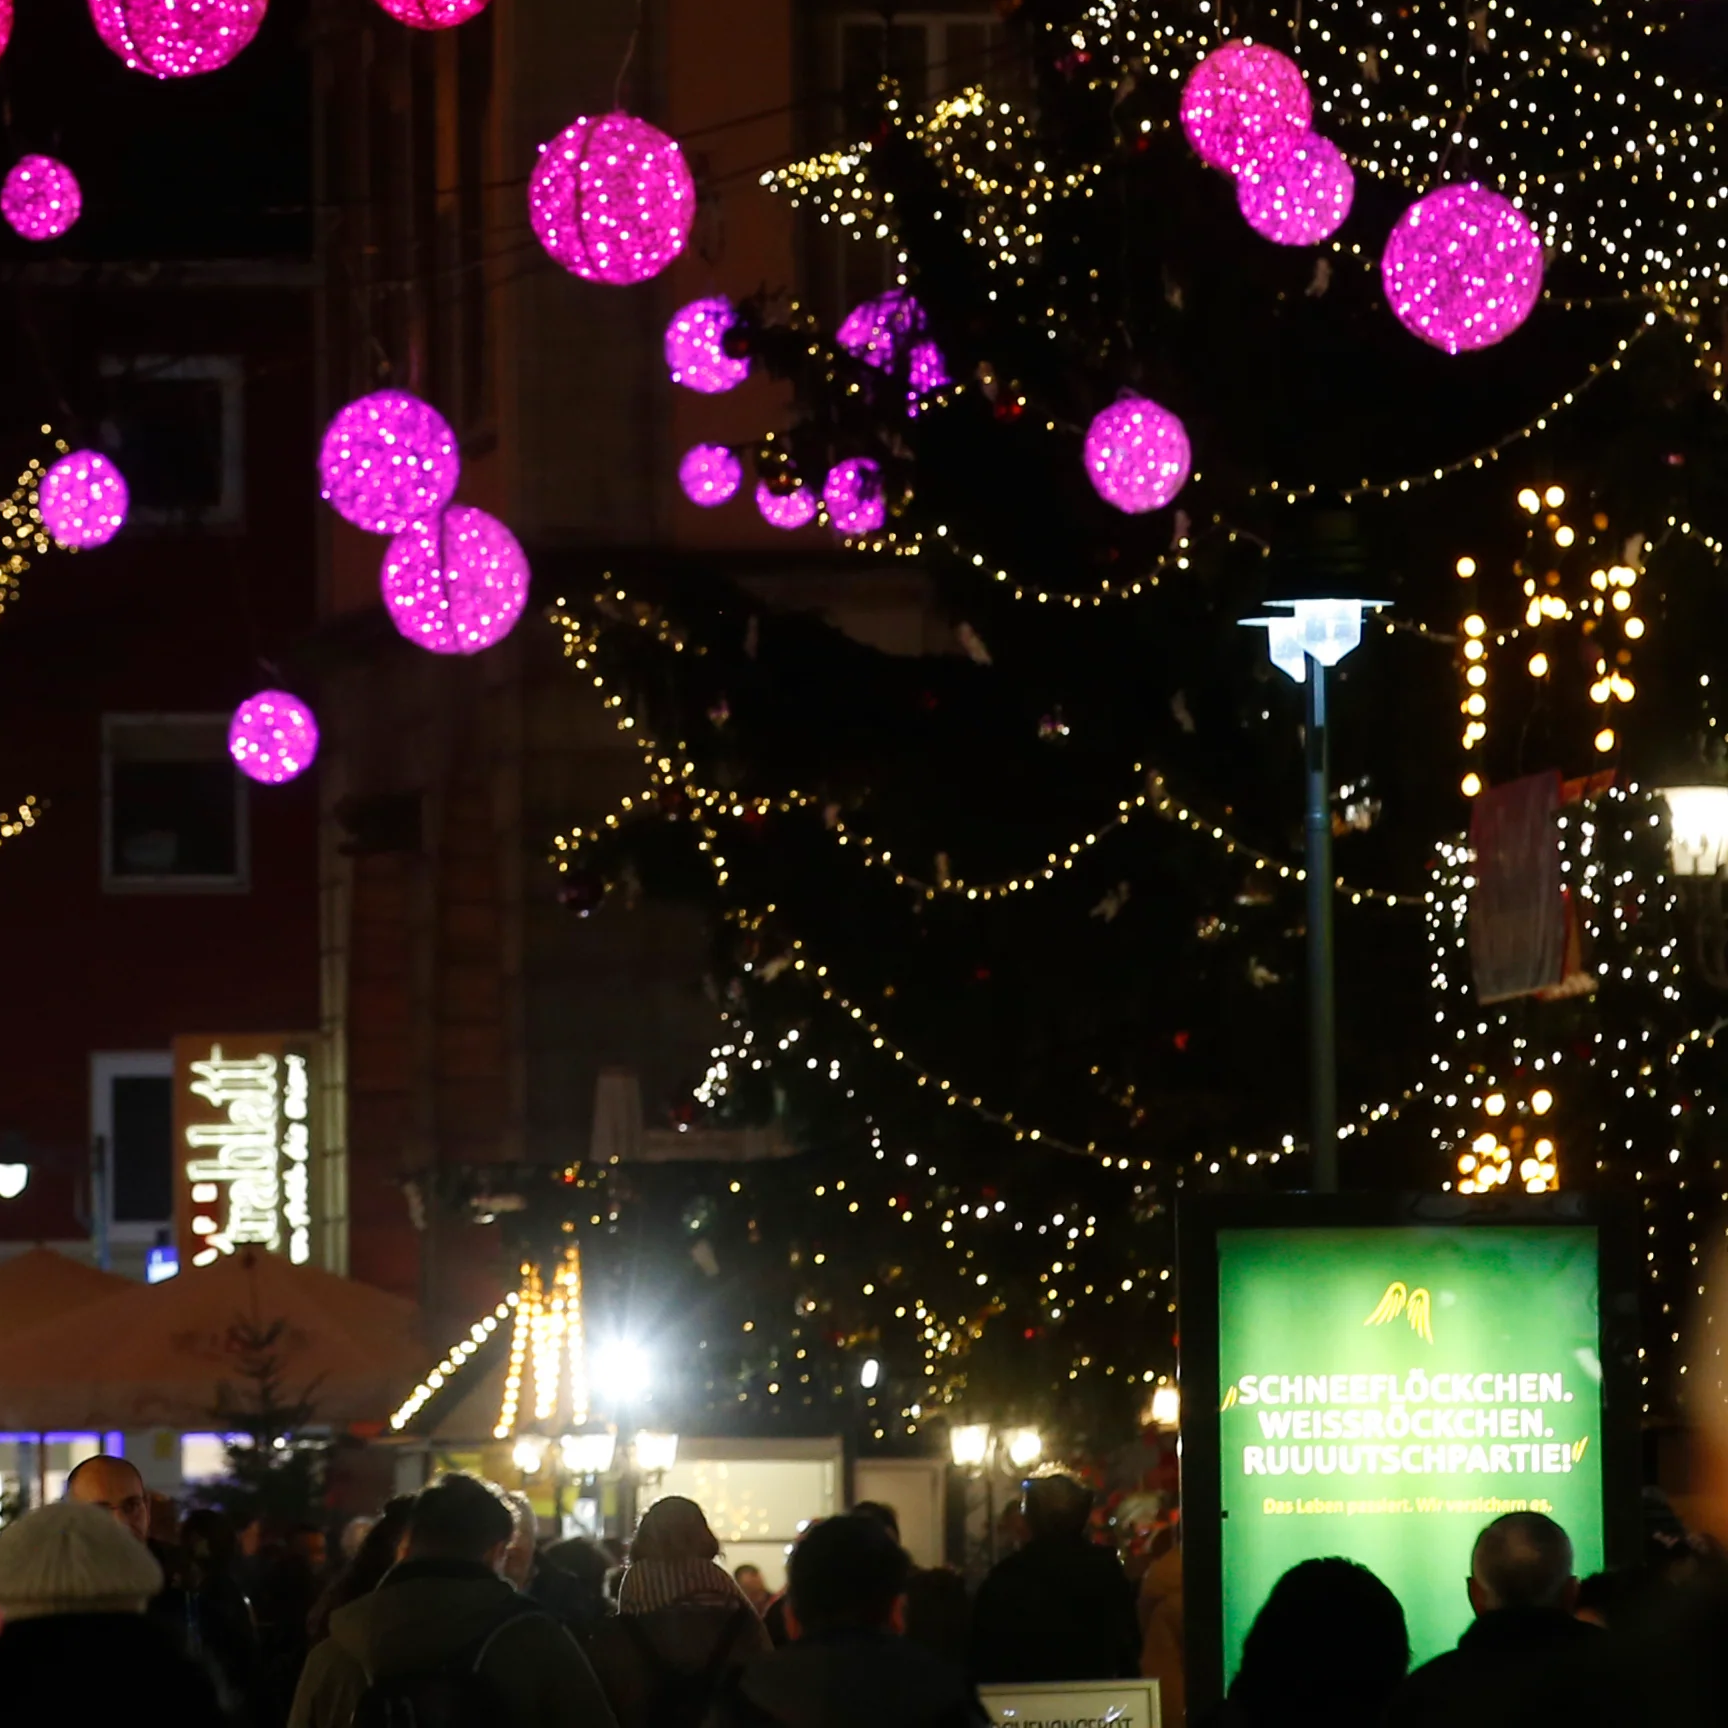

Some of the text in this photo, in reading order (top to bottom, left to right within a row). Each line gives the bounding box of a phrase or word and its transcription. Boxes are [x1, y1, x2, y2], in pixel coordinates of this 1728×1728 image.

[1258, 1404, 1554, 1440] WEISSRÖCKCHEN.
[1263, 1498, 1294, 1514] Das
[1296, 1498, 1344, 1514] Leben
[1415, 1497, 1444, 1513] Wir
